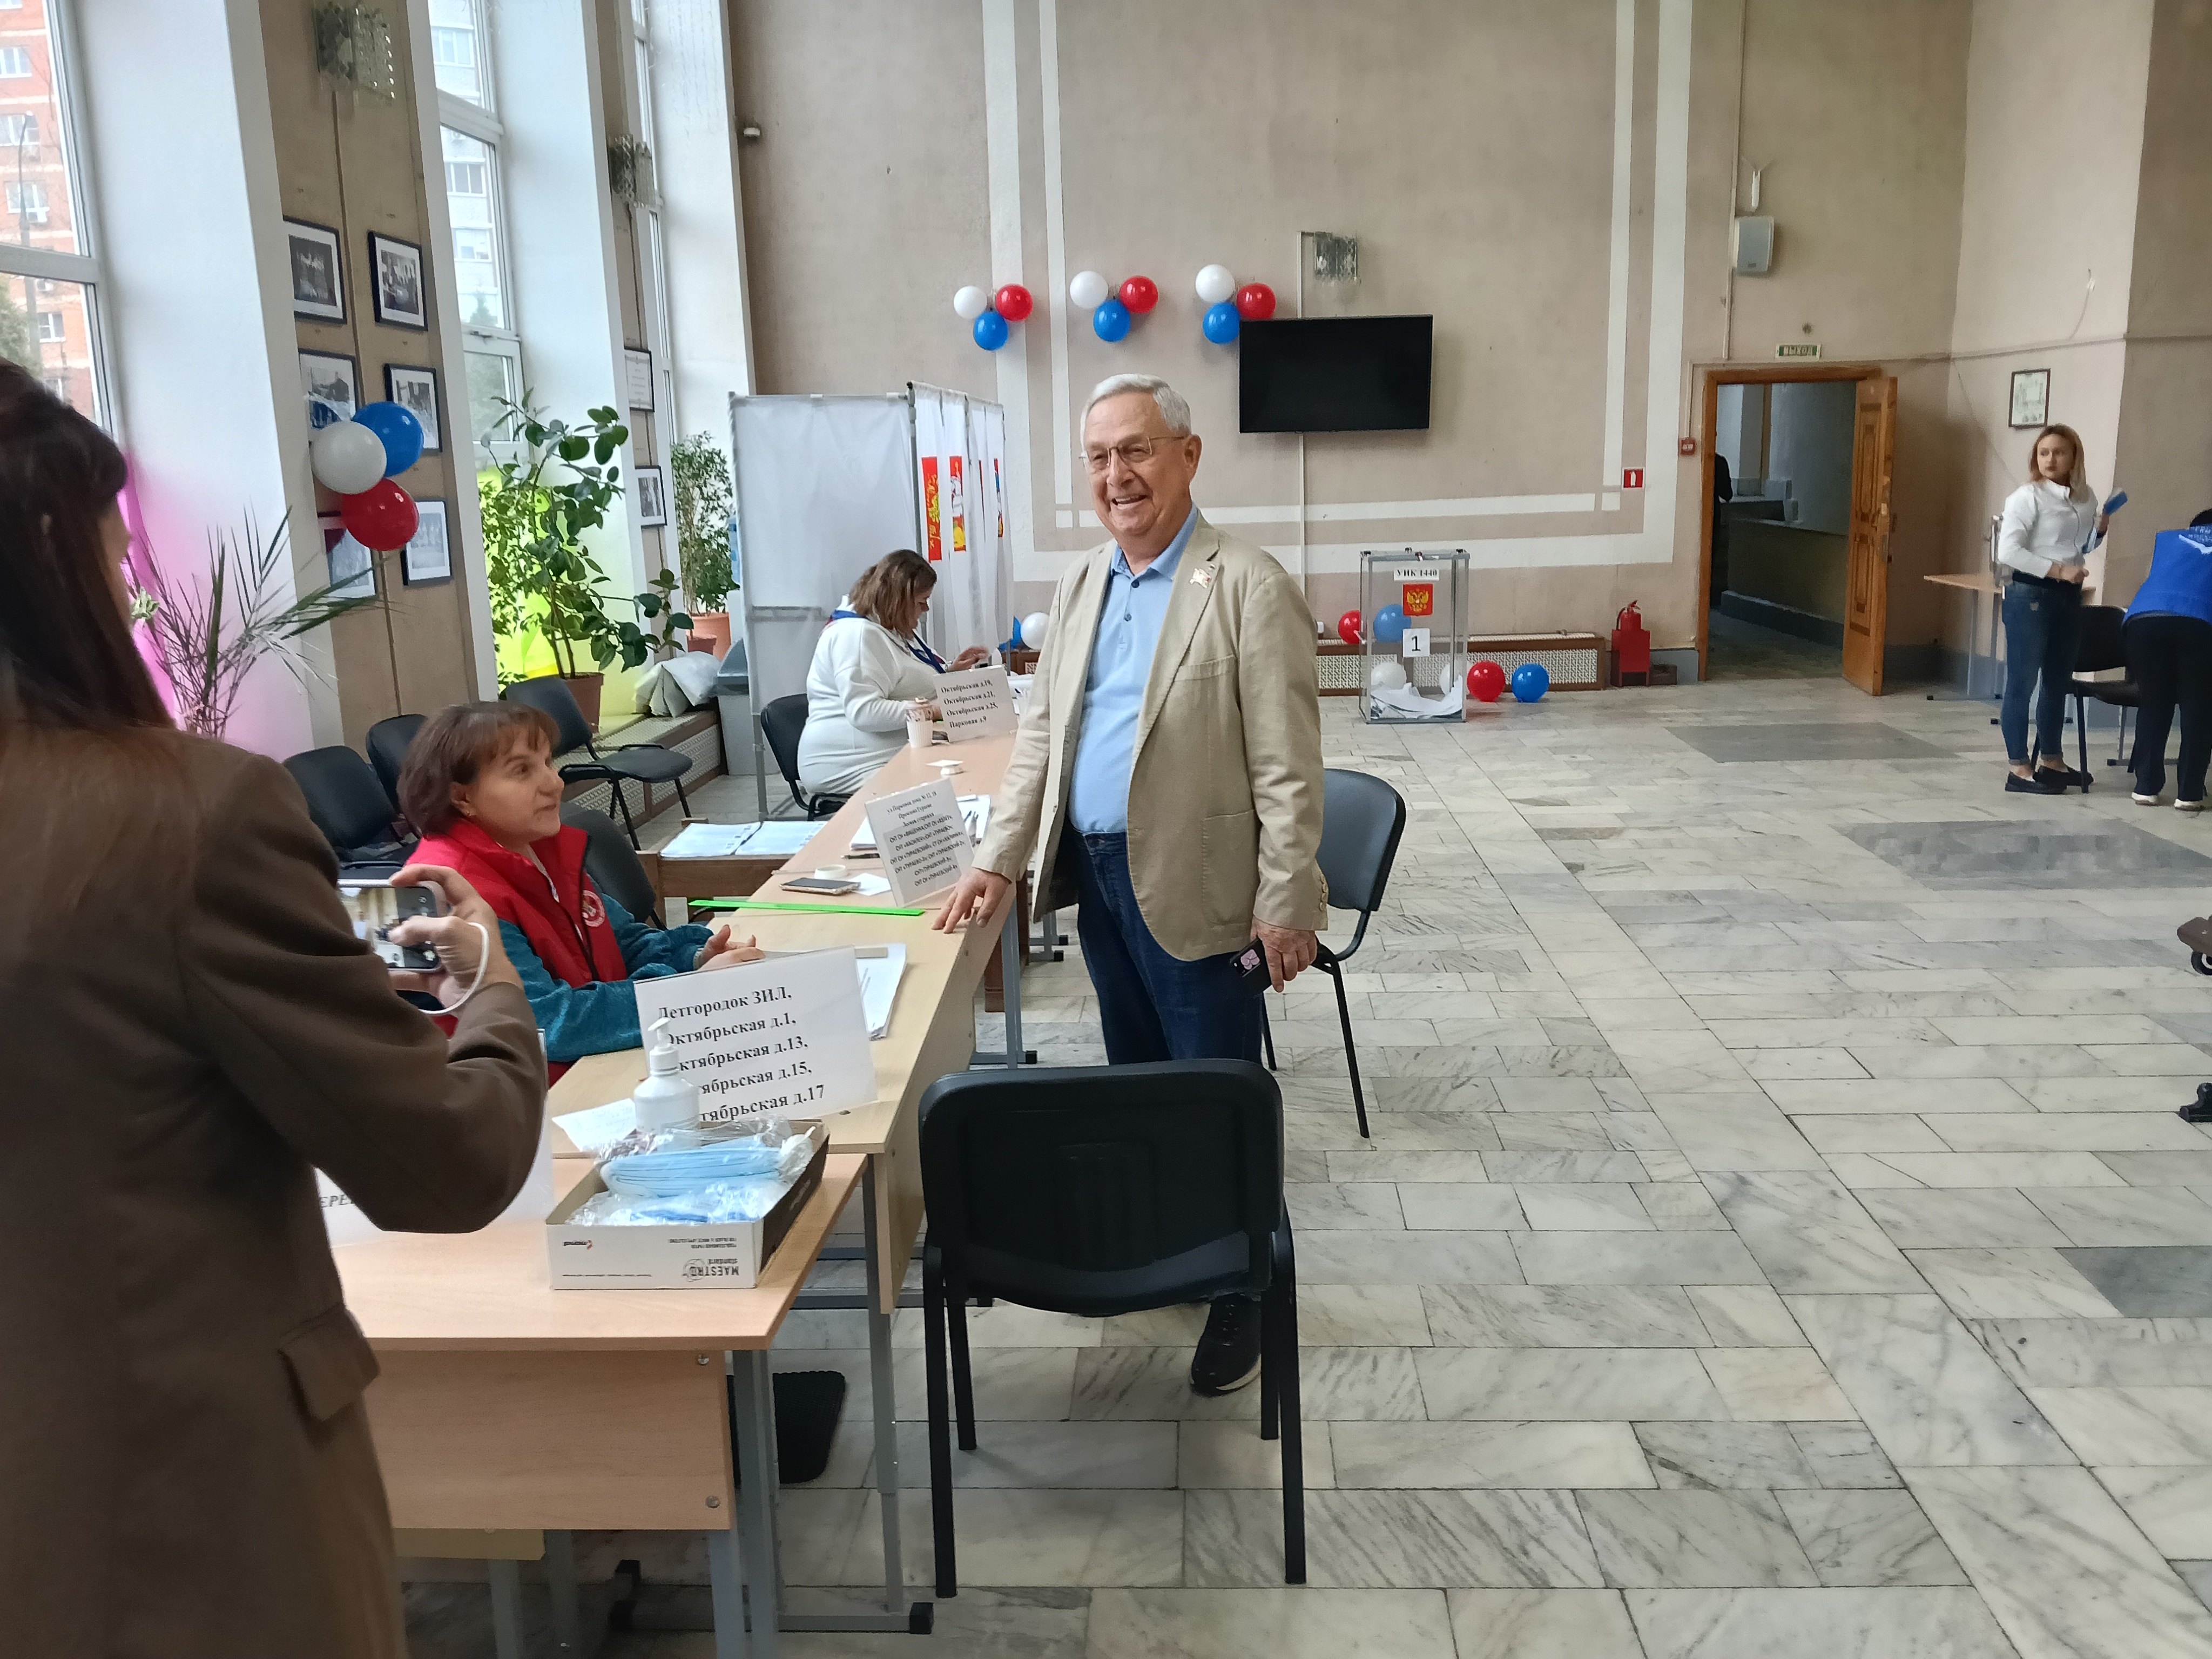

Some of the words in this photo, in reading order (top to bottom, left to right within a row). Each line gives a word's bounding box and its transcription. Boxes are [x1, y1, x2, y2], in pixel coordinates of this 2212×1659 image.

[1411, 636, 1421, 651] 1
[941, 683, 979, 693] Октябрьская
[943, 694, 982, 705] Октябрьская
[946, 705, 984, 716] Октябрьская
[753, 986, 792, 1005] ЗИЛ,
[770, 1013, 797, 1028] д.1,
[679, 1045, 770, 1071] ктябрьская
[774, 1035, 808, 1054] д.13,
[699, 1071, 773, 1094] ябрьская
[778, 1061, 812, 1080] д.15,
[699, 1096, 788, 1121] тябрьская
[793, 1084, 824, 1105] д.17
[689, 1266, 739, 1276] MAESTRO
